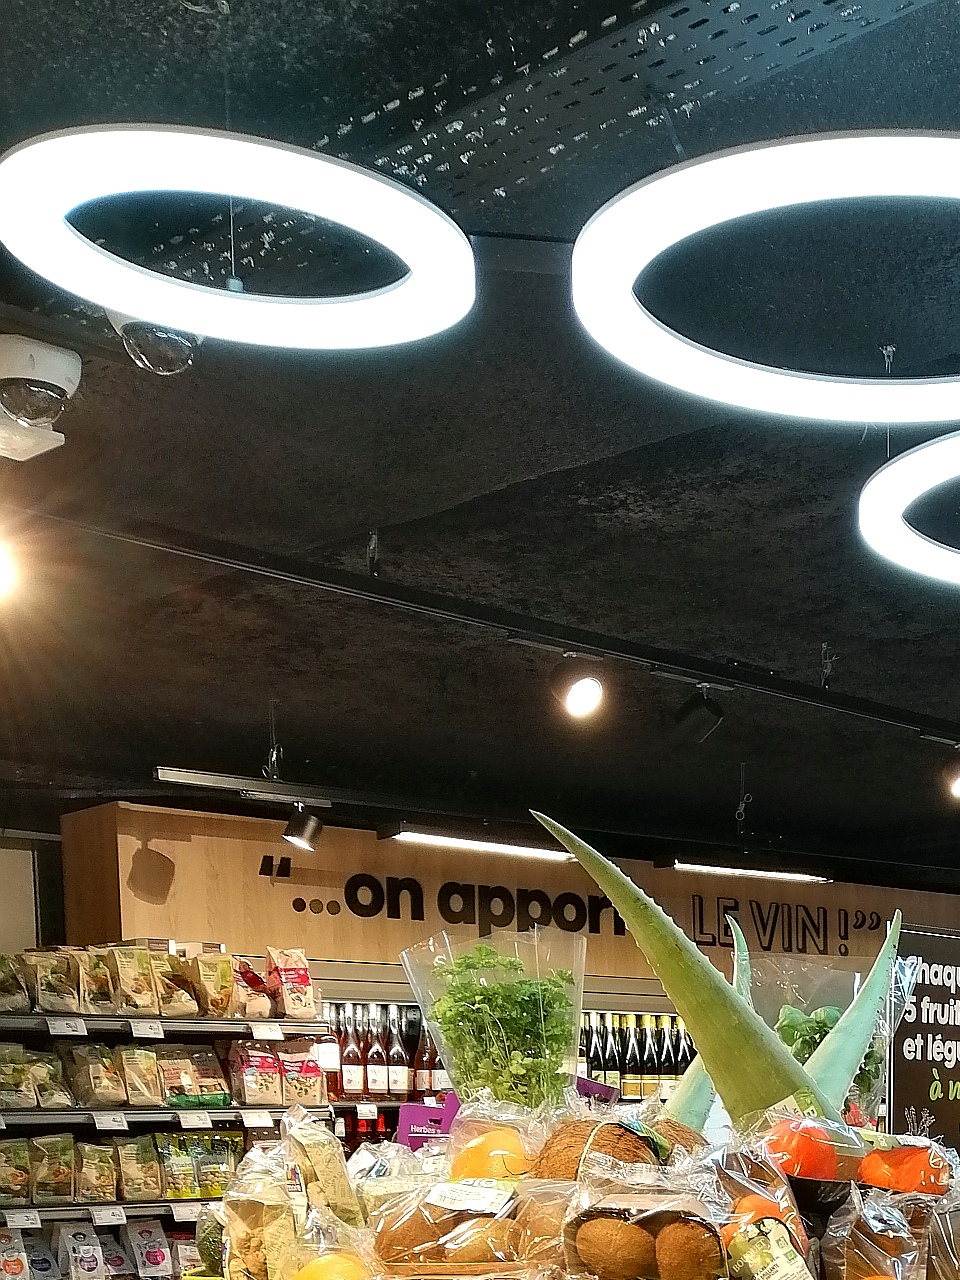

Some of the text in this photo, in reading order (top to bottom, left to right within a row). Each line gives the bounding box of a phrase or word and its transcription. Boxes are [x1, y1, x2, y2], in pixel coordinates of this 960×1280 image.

[692, 894, 743, 948] LE
[749, 899, 828, 955] VIN
[904, 997, 917, 1023] 5
[903, 1036, 924, 1061] et
[929, 1068, 944, 1102] à
